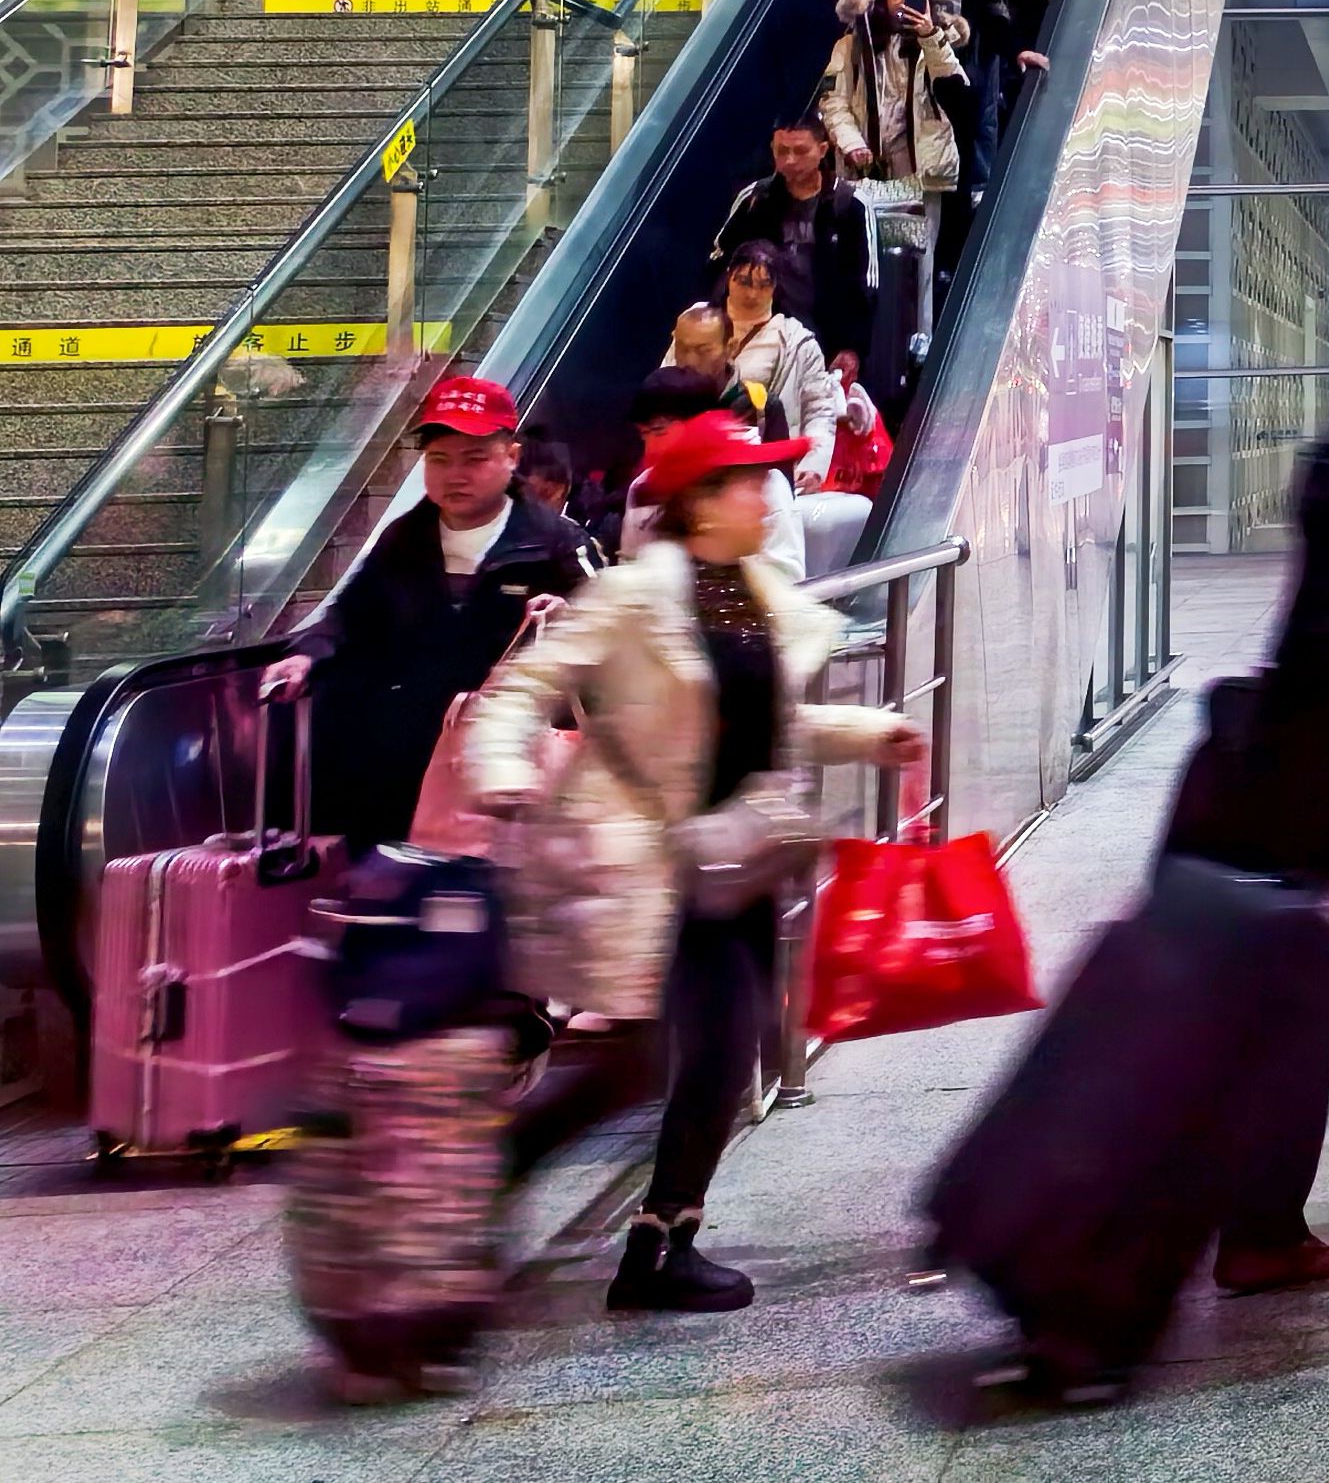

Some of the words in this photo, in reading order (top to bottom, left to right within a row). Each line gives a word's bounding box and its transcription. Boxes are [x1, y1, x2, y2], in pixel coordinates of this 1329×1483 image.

[363, 0, 495, 14] 非出站通
[12, 337, 81, 357] 通道
